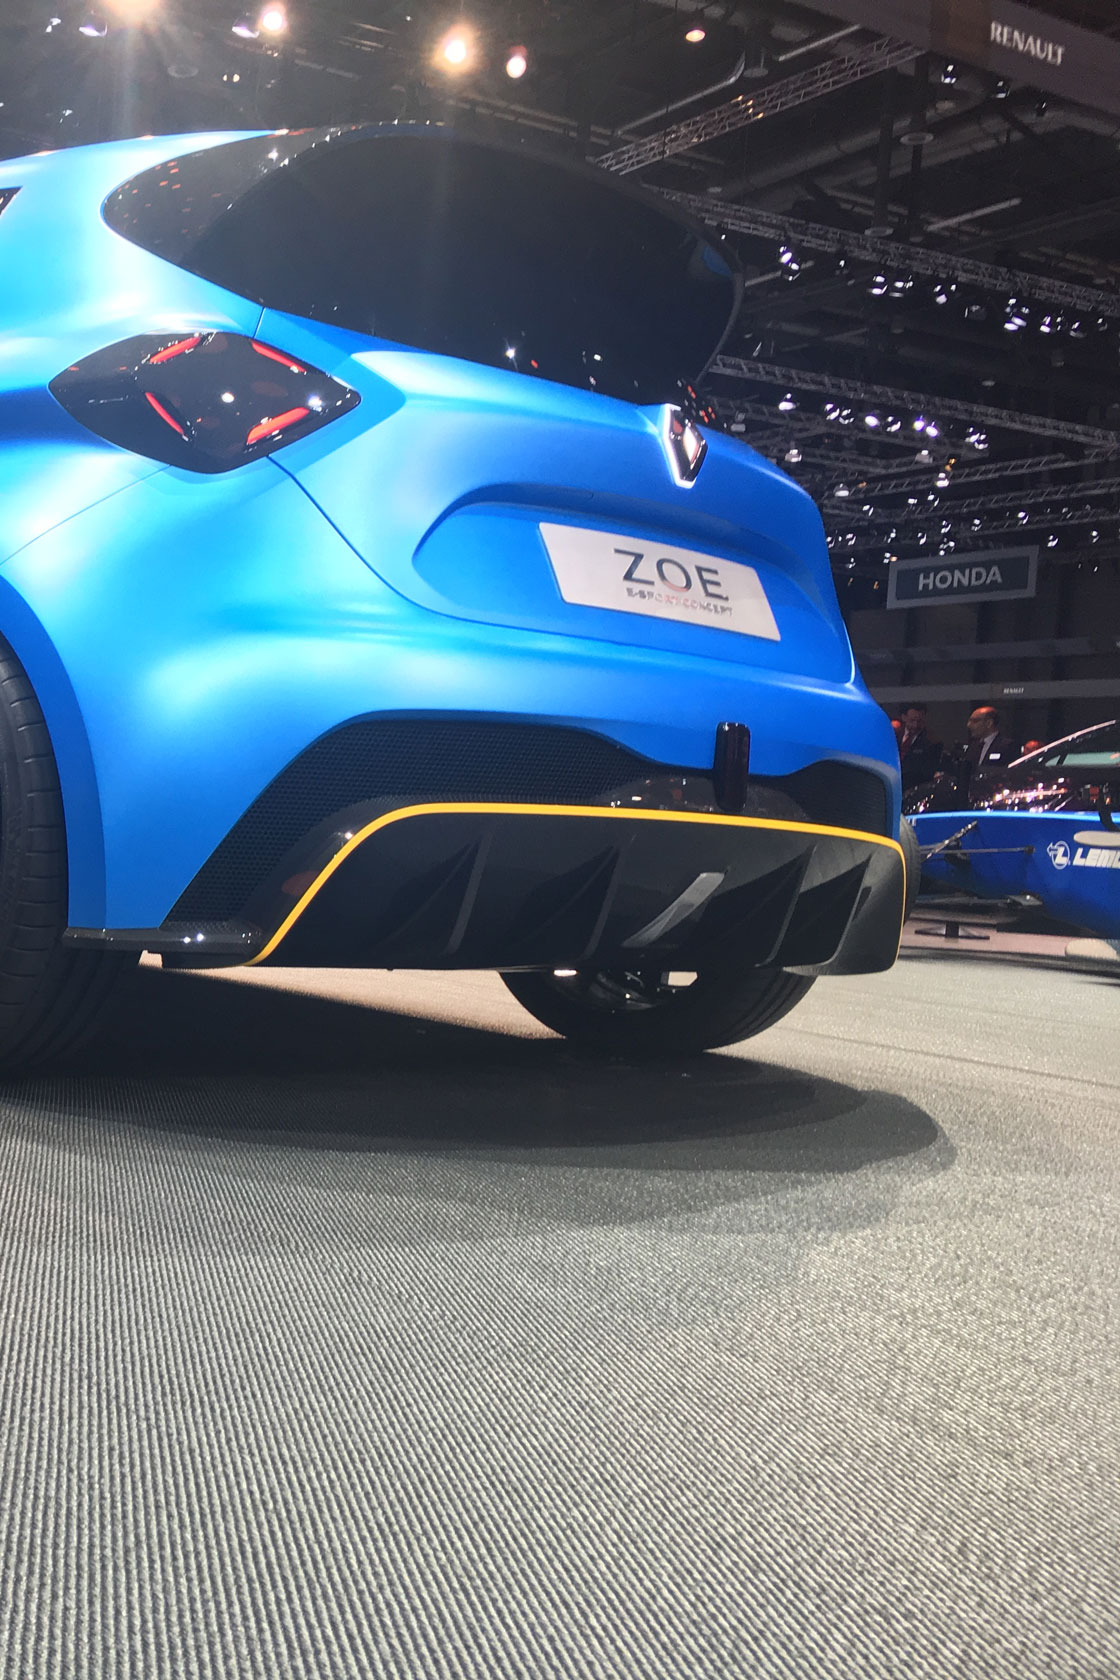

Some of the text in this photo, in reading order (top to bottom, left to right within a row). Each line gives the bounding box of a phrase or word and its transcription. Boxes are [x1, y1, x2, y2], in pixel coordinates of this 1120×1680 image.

[990, 21, 1064, 66] RENAULT
[614, 548, 729, 601] ZOE
[918, 565, 1002, 592] HONDA
